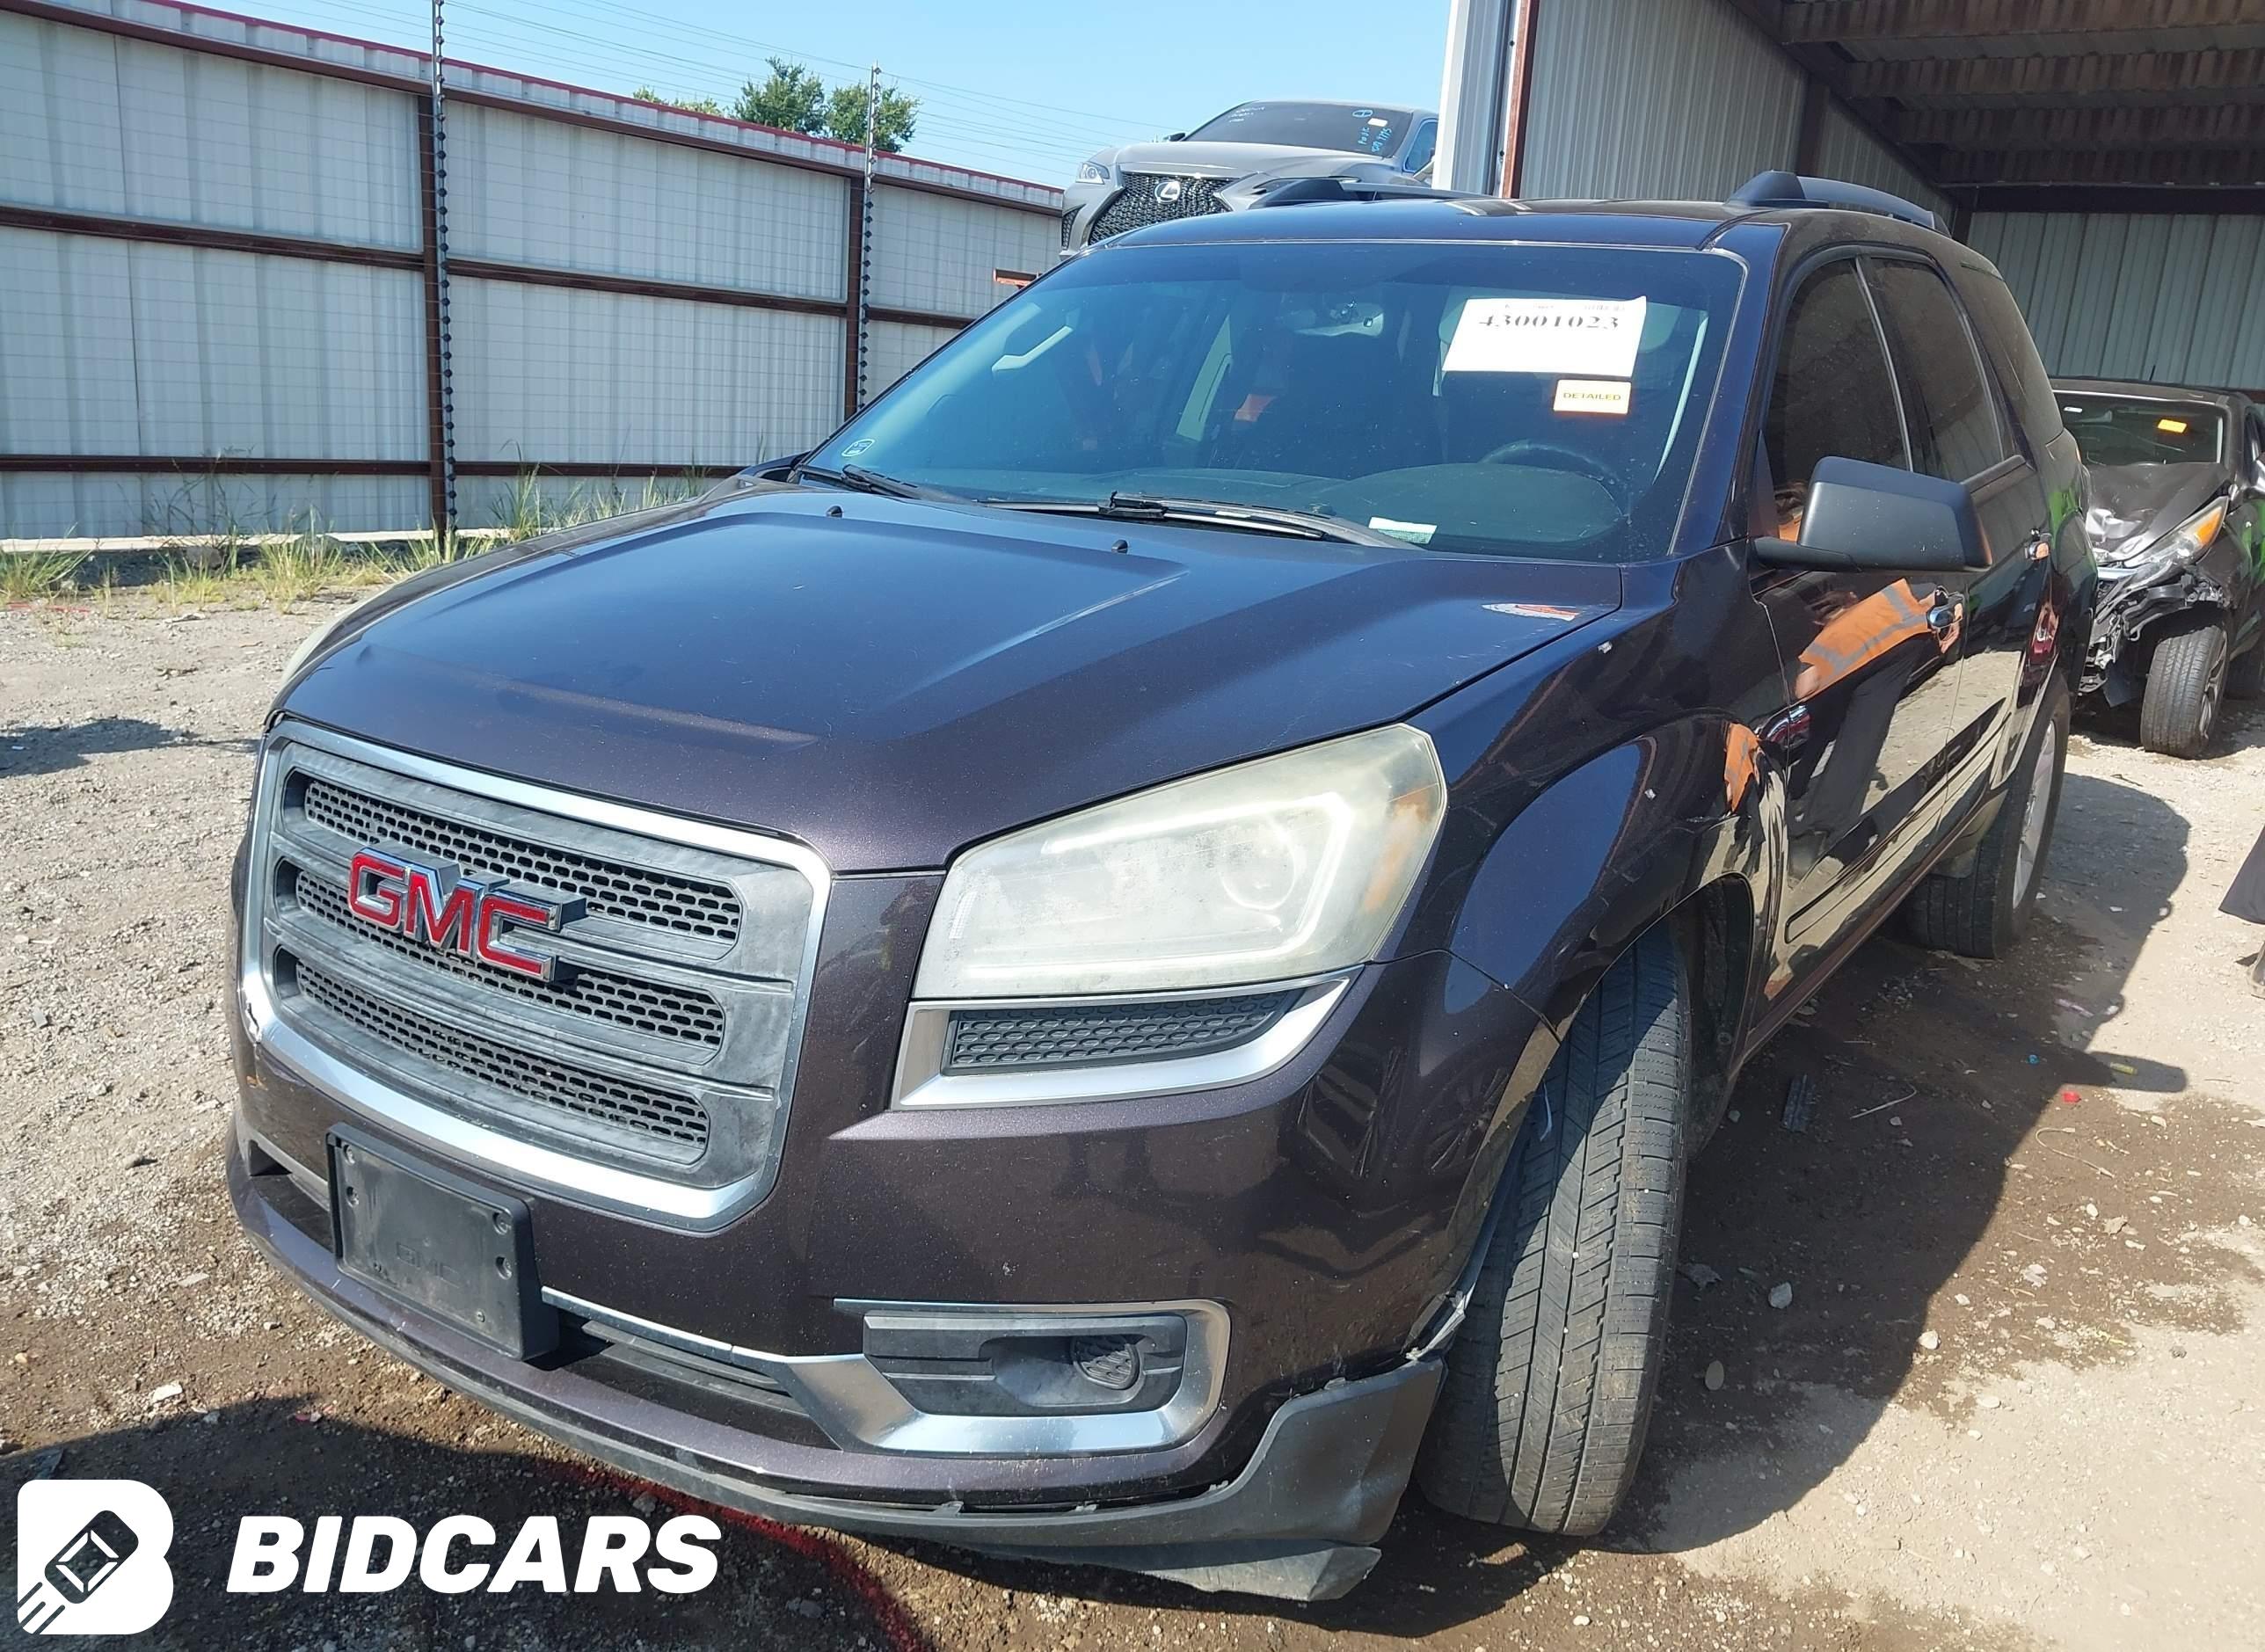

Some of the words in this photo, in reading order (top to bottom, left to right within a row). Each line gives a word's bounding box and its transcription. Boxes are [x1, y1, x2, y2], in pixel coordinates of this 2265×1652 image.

[1479, 314, 1619, 330] 43001023
[1562, 392, 1621, 401] DETAILED
[348, 844, 563, 983] GMC
